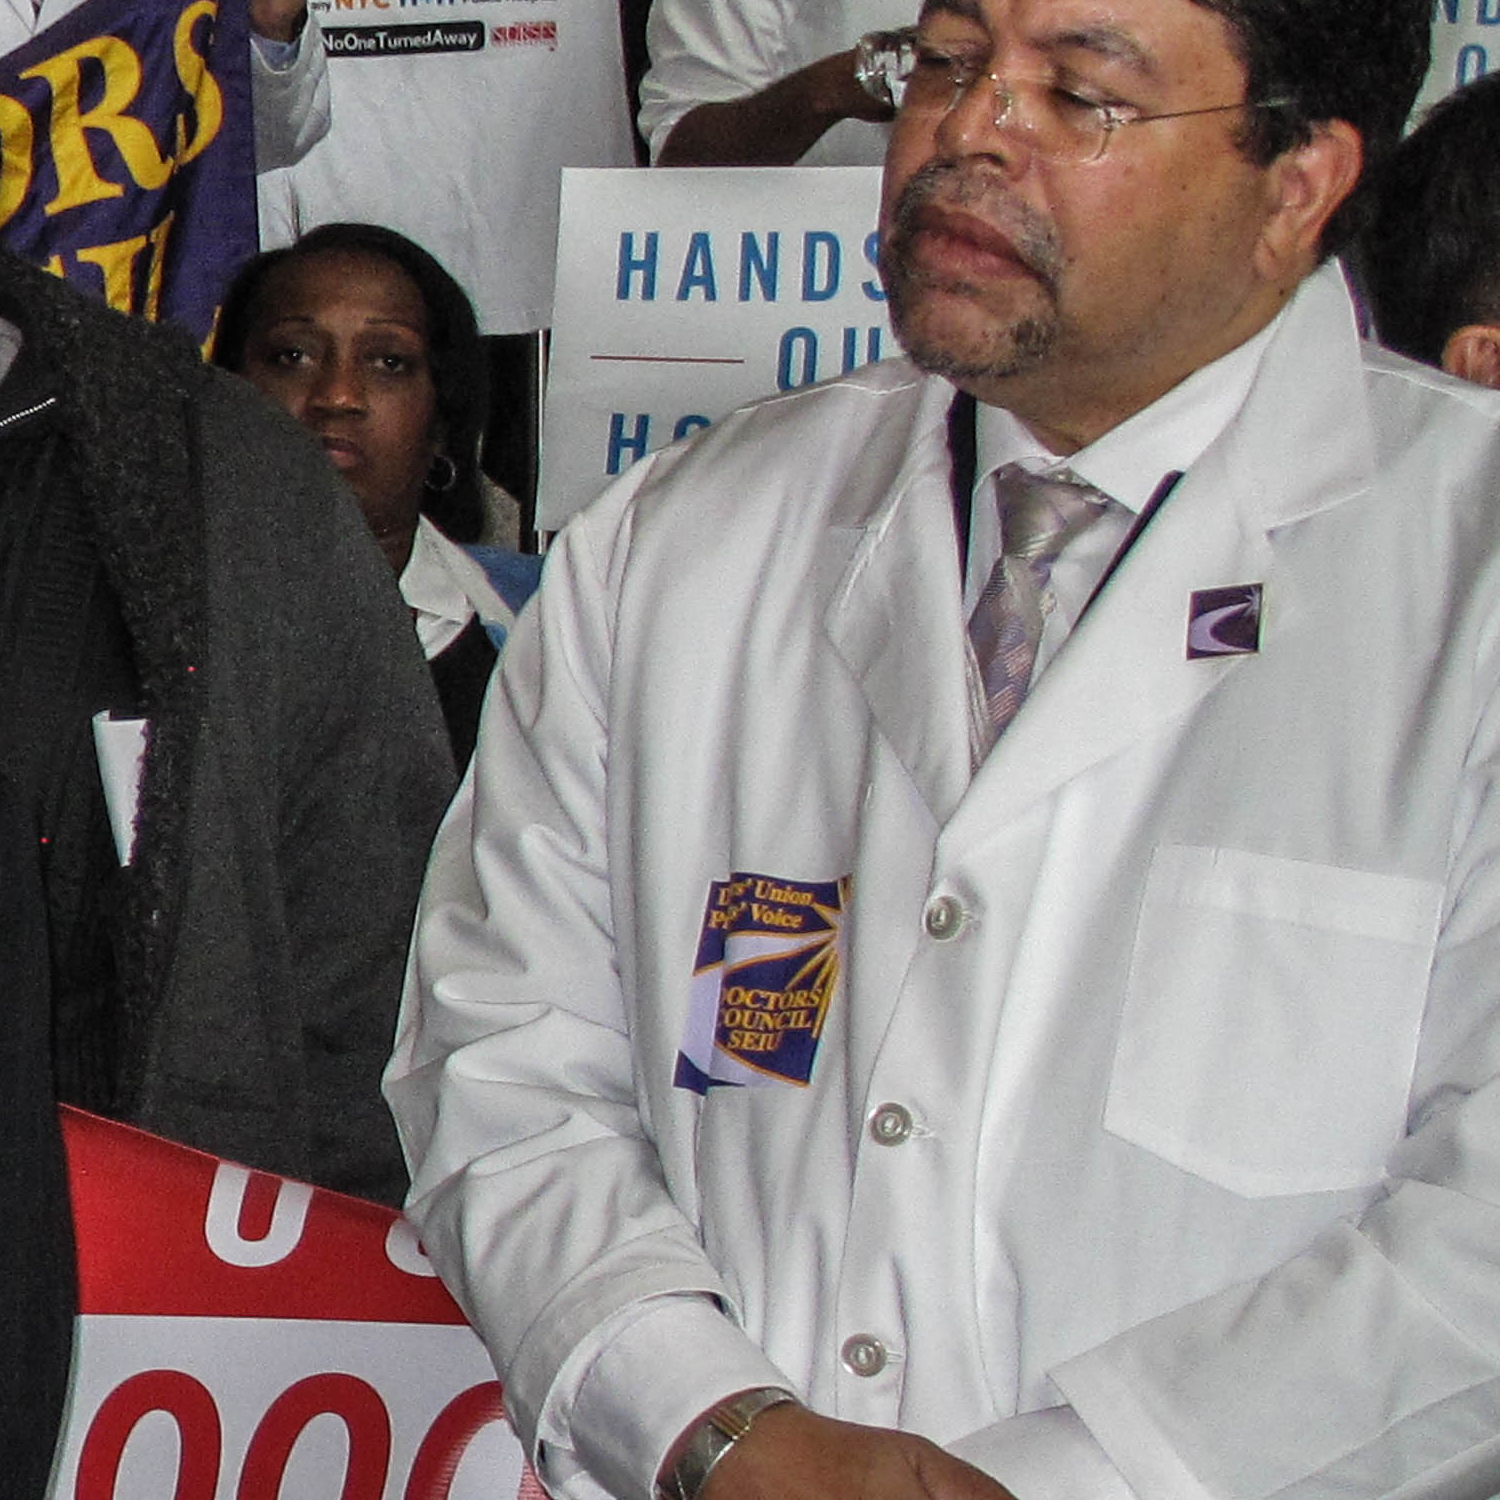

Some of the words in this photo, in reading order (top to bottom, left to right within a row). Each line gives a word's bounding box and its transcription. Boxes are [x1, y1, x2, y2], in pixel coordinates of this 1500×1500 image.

[322, 29, 478, 51] NoOneTurnedAway
[776, 327, 884, 392] OU
[754, 878, 814, 906] Union
[750, 902, 804, 929] Voice
[725, 986, 825, 1008] OCTORS
[722, 1009, 813, 1031] OUNCIL
